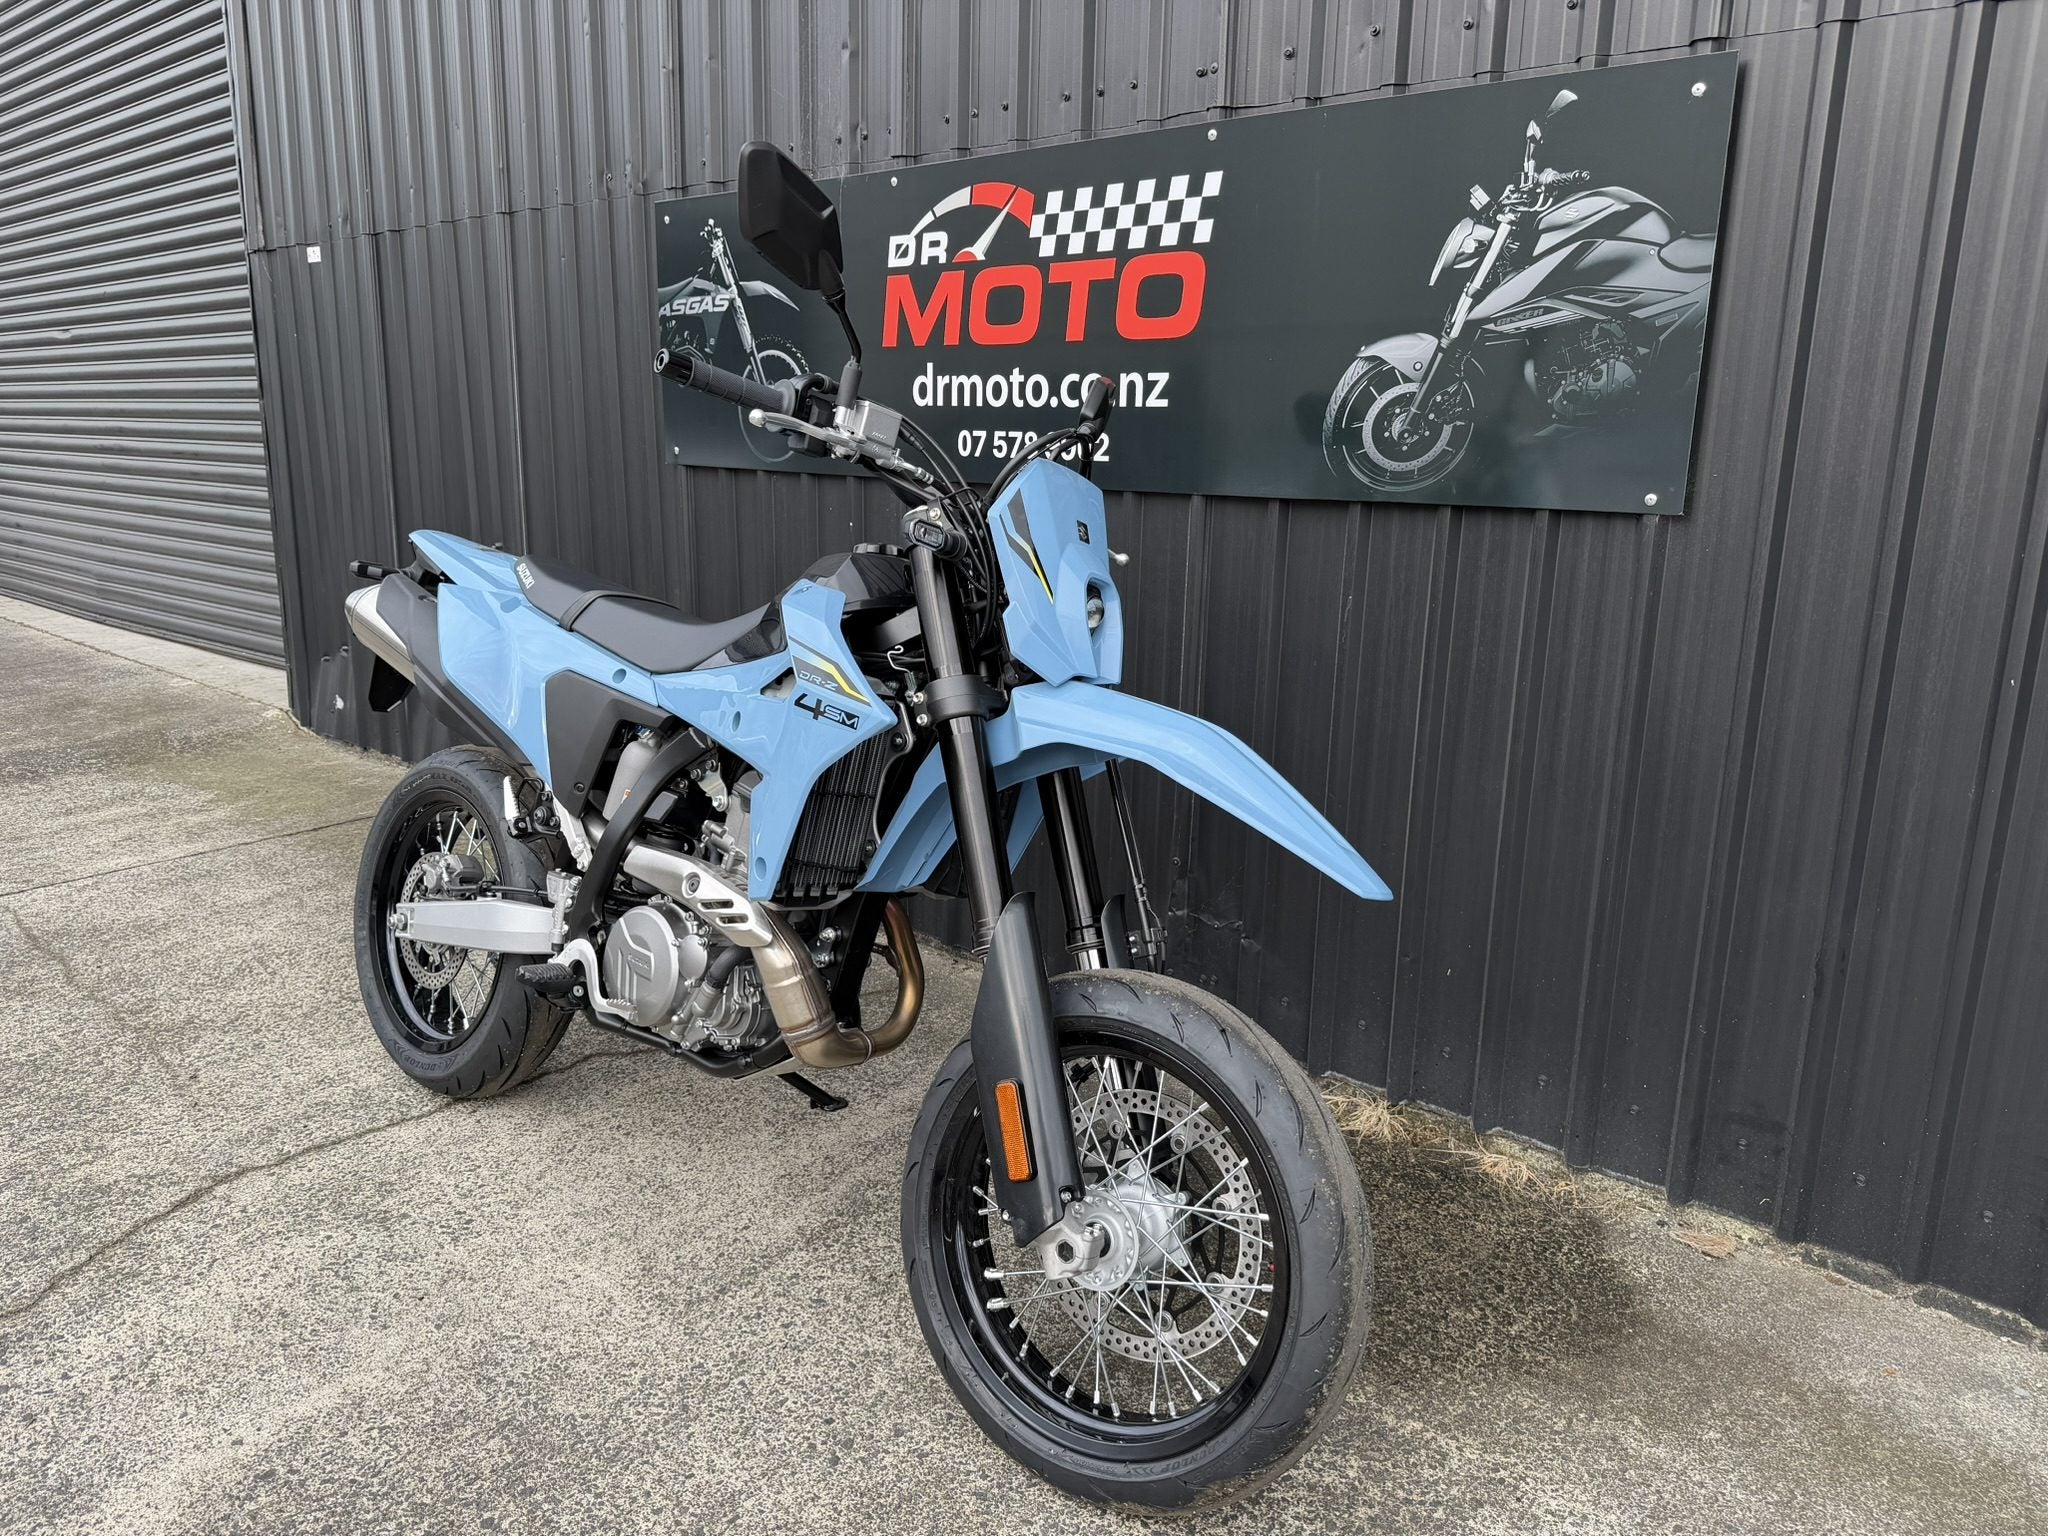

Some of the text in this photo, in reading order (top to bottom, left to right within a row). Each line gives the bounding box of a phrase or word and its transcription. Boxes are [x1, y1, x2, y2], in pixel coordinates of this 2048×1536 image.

[888, 231, 949, 268] DR
[882, 251, 1207, 348] MOTO
[957, 430, 987, 457] 07
[516, 563, 536, 590] SUZUKI
[799, 670, 839, 691] DR-Z
